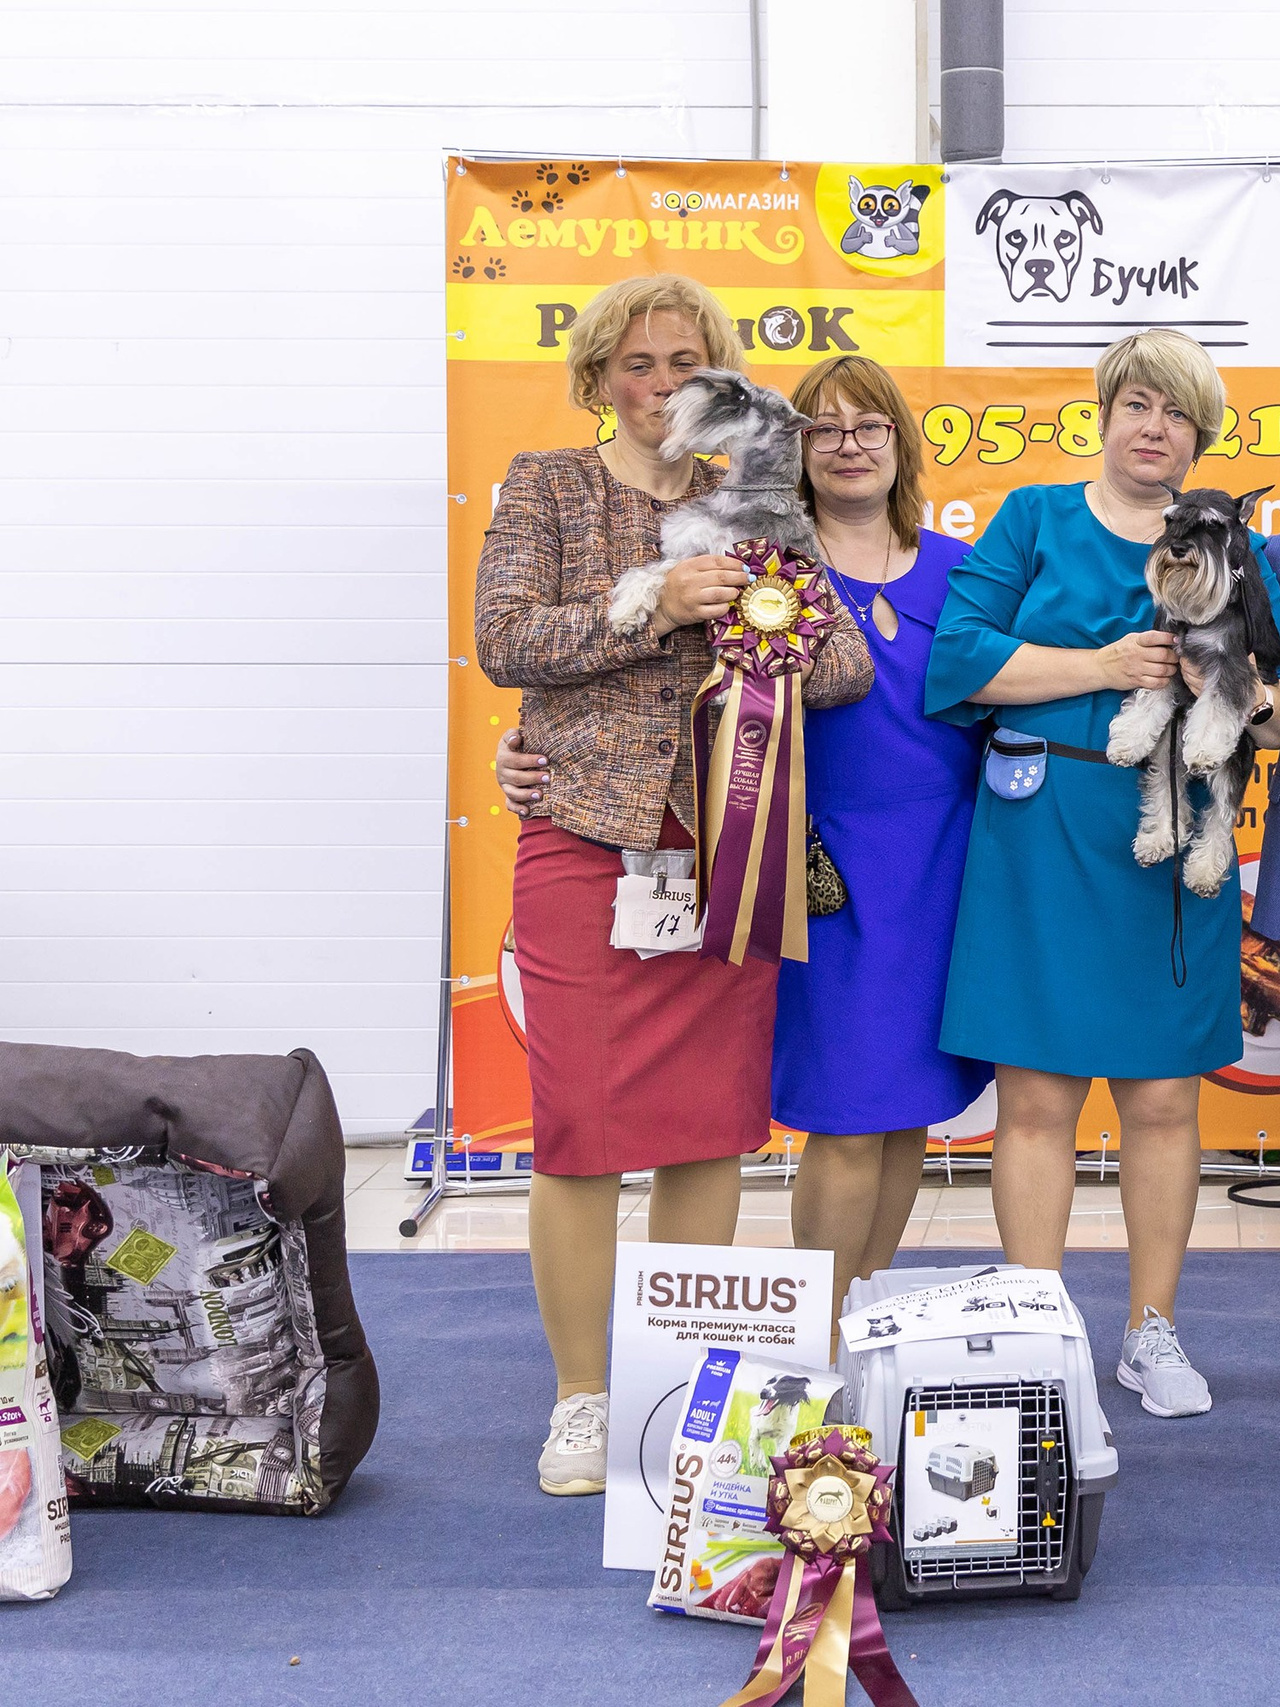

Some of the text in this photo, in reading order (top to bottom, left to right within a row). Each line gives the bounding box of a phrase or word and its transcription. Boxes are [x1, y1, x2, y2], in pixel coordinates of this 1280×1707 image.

[650, 190, 800, 213] ЗООМАГАЗИН
[460, 205, 805, 265] Лемурчик
[652, 890, 692, 902] SIRIUS
[654, 913, 681, 937] 17
[648, 1271, 797, 1314] SIRIUS
[199, 1290, 239, 1348] LONDON
[648, 1317, 796, 1334] Корма премиум-класса
[676, 1331, 795, 1345] для кошек и собак
[690, 1407, 717, 1423] ADULT
[713, 1481, 752, 1493] ИНДЕЙКА
[718, 1491, 739, 1501] УТКА
[660, 1453, 704, 1592] SIRIUS
